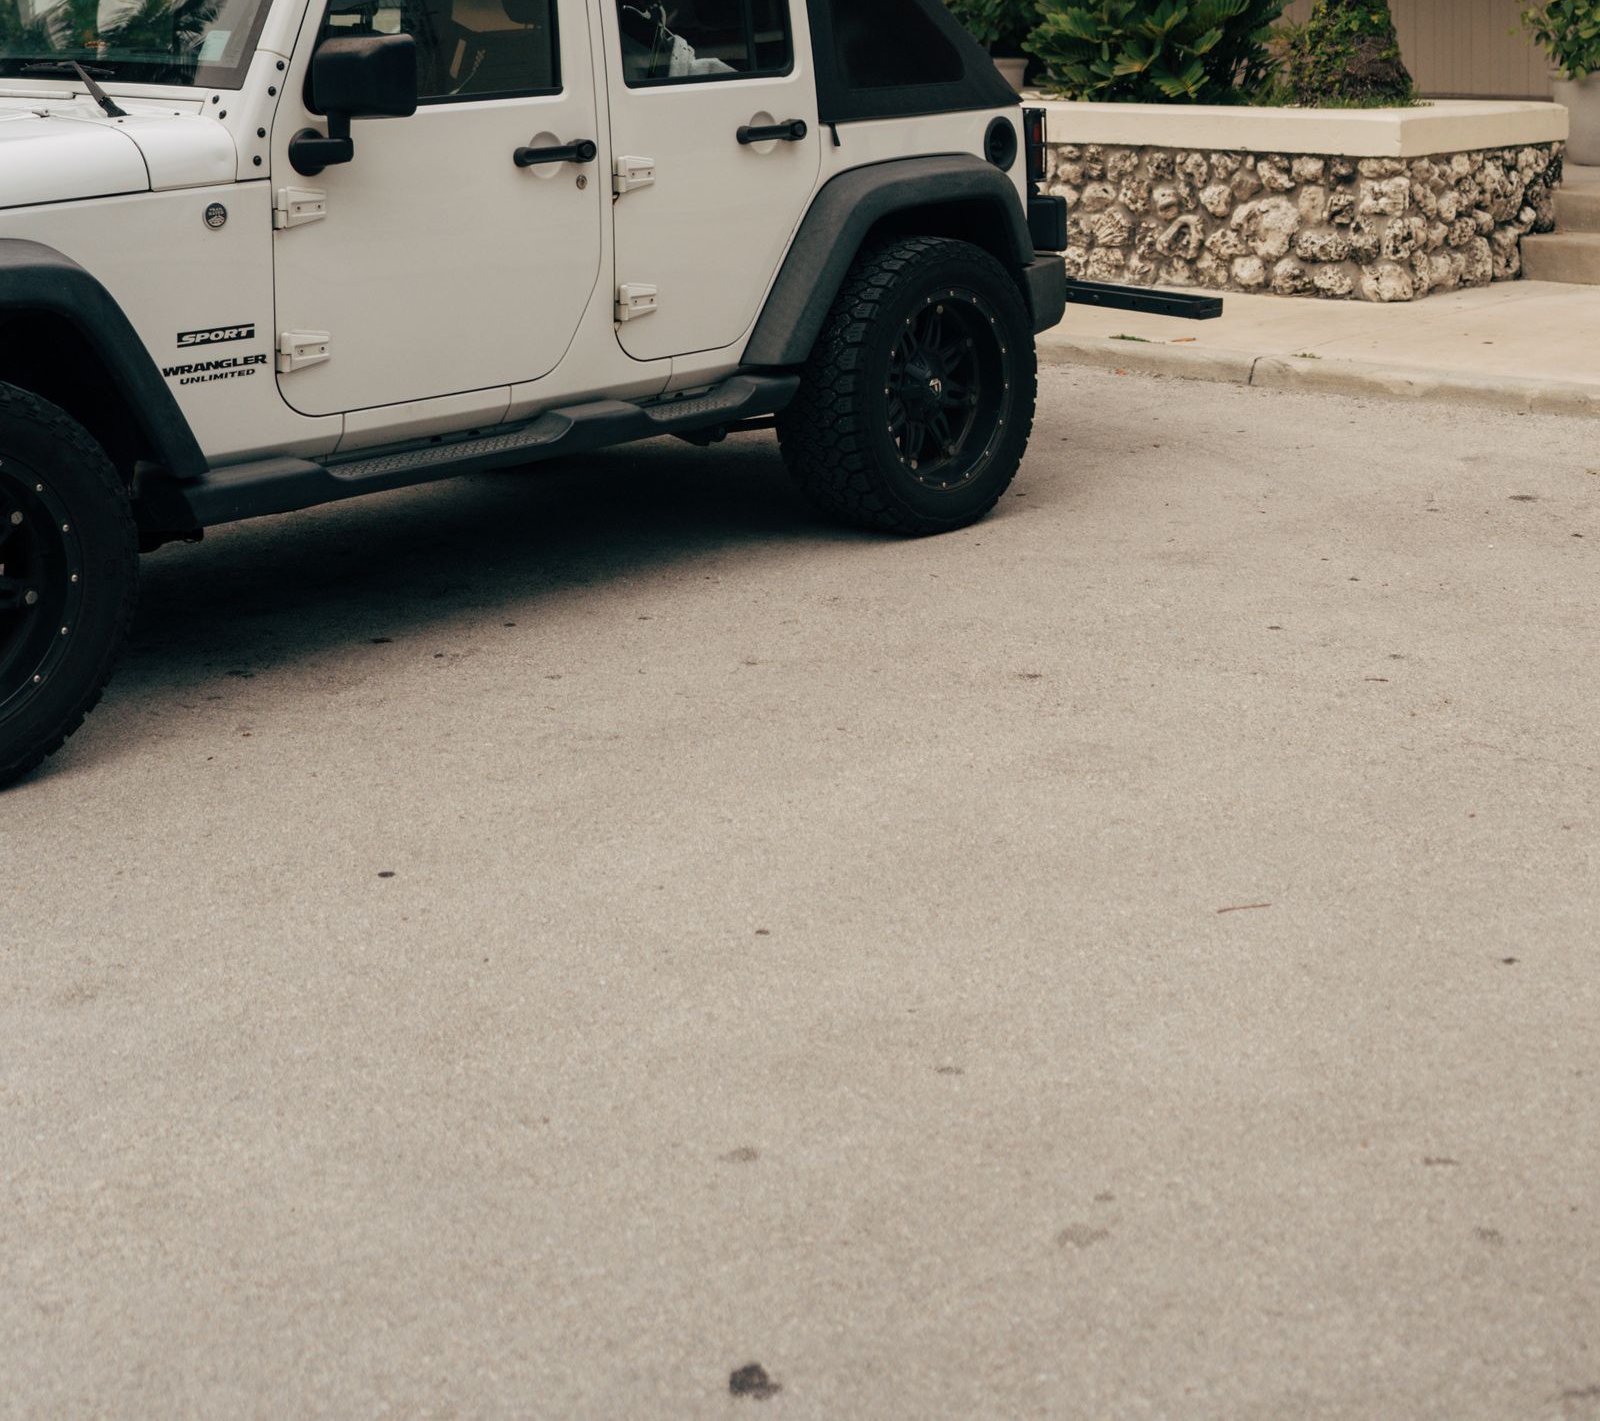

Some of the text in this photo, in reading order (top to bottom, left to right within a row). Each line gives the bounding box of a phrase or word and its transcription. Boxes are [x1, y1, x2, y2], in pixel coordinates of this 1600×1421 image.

[181, 327, 250, 344] SPORT
[162, 354, 267, 378] WRANGLER
[180, 368, 255, 385] UNLIMITED
